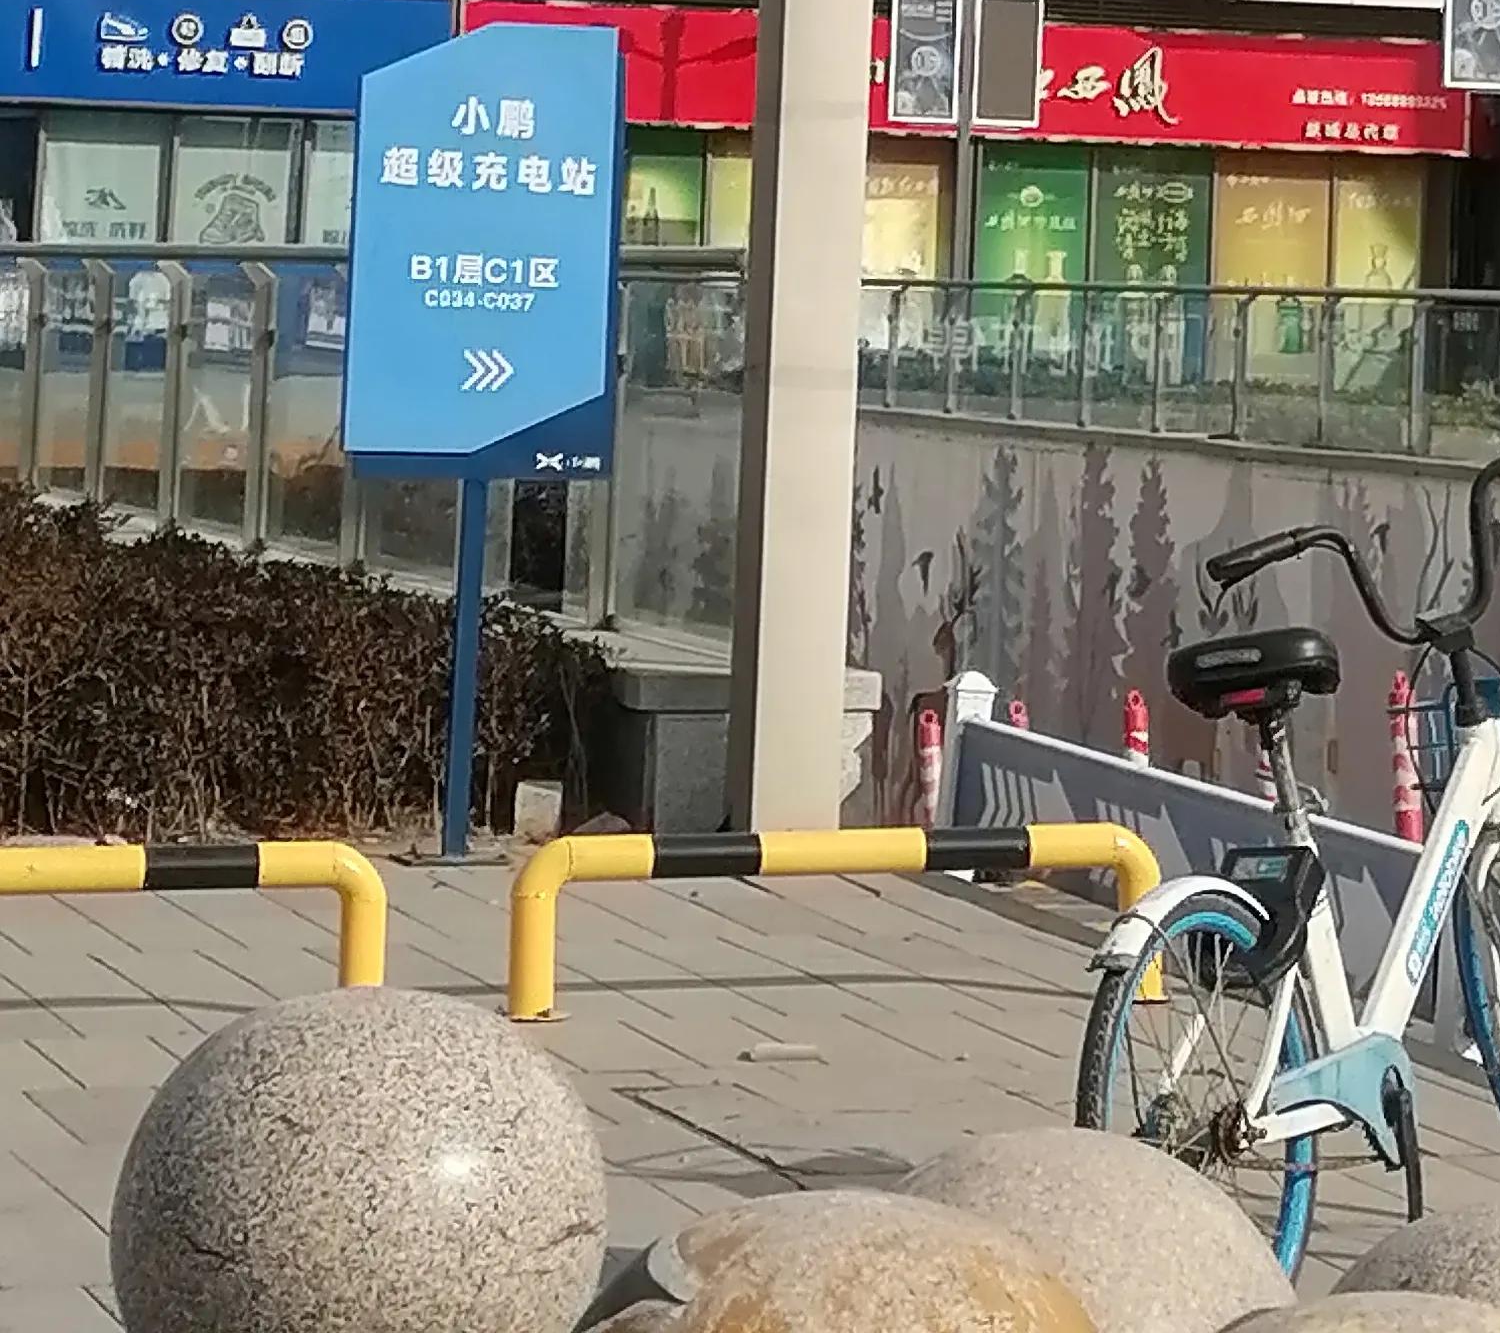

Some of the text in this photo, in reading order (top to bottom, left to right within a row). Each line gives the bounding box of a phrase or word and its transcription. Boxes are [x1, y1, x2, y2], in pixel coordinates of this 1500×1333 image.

[451, 95, 535, 139] 小鹏
[380, 146, 597, 195] 超级充电站
[410, 253, 560, 288] B1层C1区
